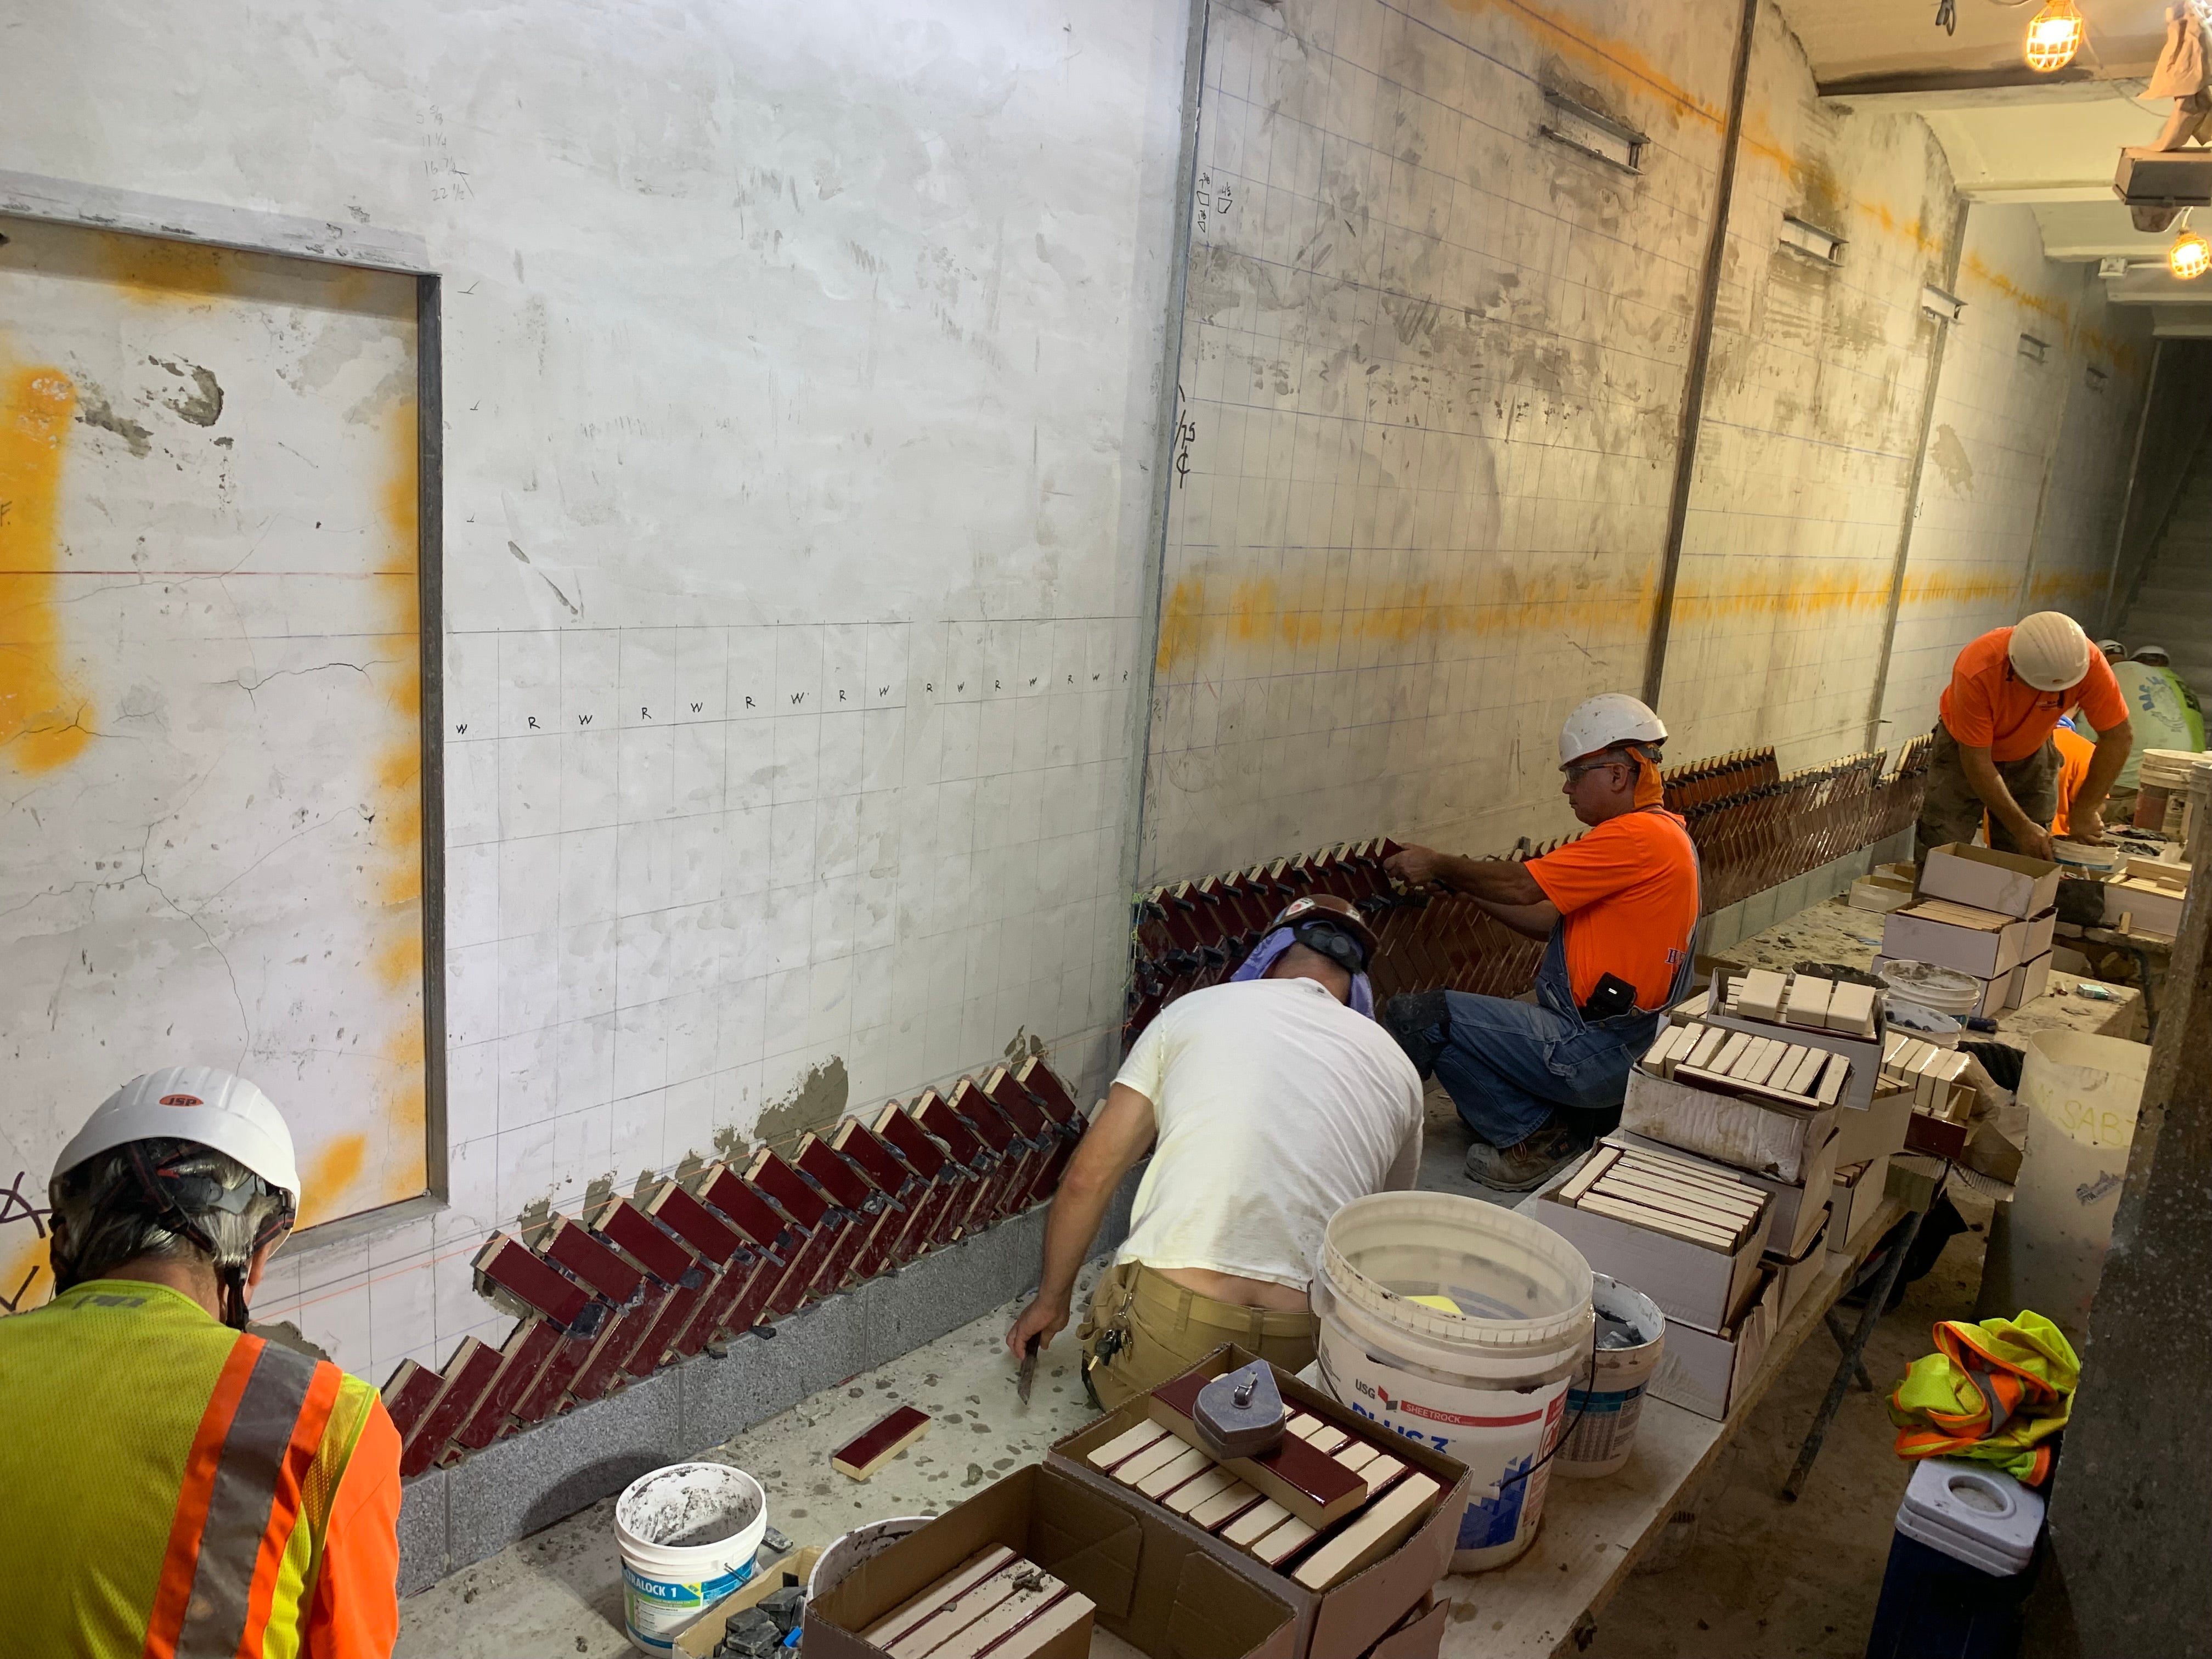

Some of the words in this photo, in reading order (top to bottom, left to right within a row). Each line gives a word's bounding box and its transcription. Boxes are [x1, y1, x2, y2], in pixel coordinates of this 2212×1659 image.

[456, 724, 467, 735] W
[528, 716, 540, 729] R
[579, 714, 592, 726] W
[641, 707, 652, 720] R
[690, 702, 703, 713] W
[745, 696, 755, 709] R
[791, 692, 804, 704] W
[839, 690, 847, 702] R
[879, 685, 890, 698] W
[926, 683, 933, 692] R
[957, 681, 965, 693] W
[995, 680, 1001, 692] R
[167, 1097, 196, 1107] JSP
[1355, 1378, 1376, 1400] USG
[1406, 1403, 1462, 1424] SHEETROCK
[671, 1587, 677, 1598] 1
